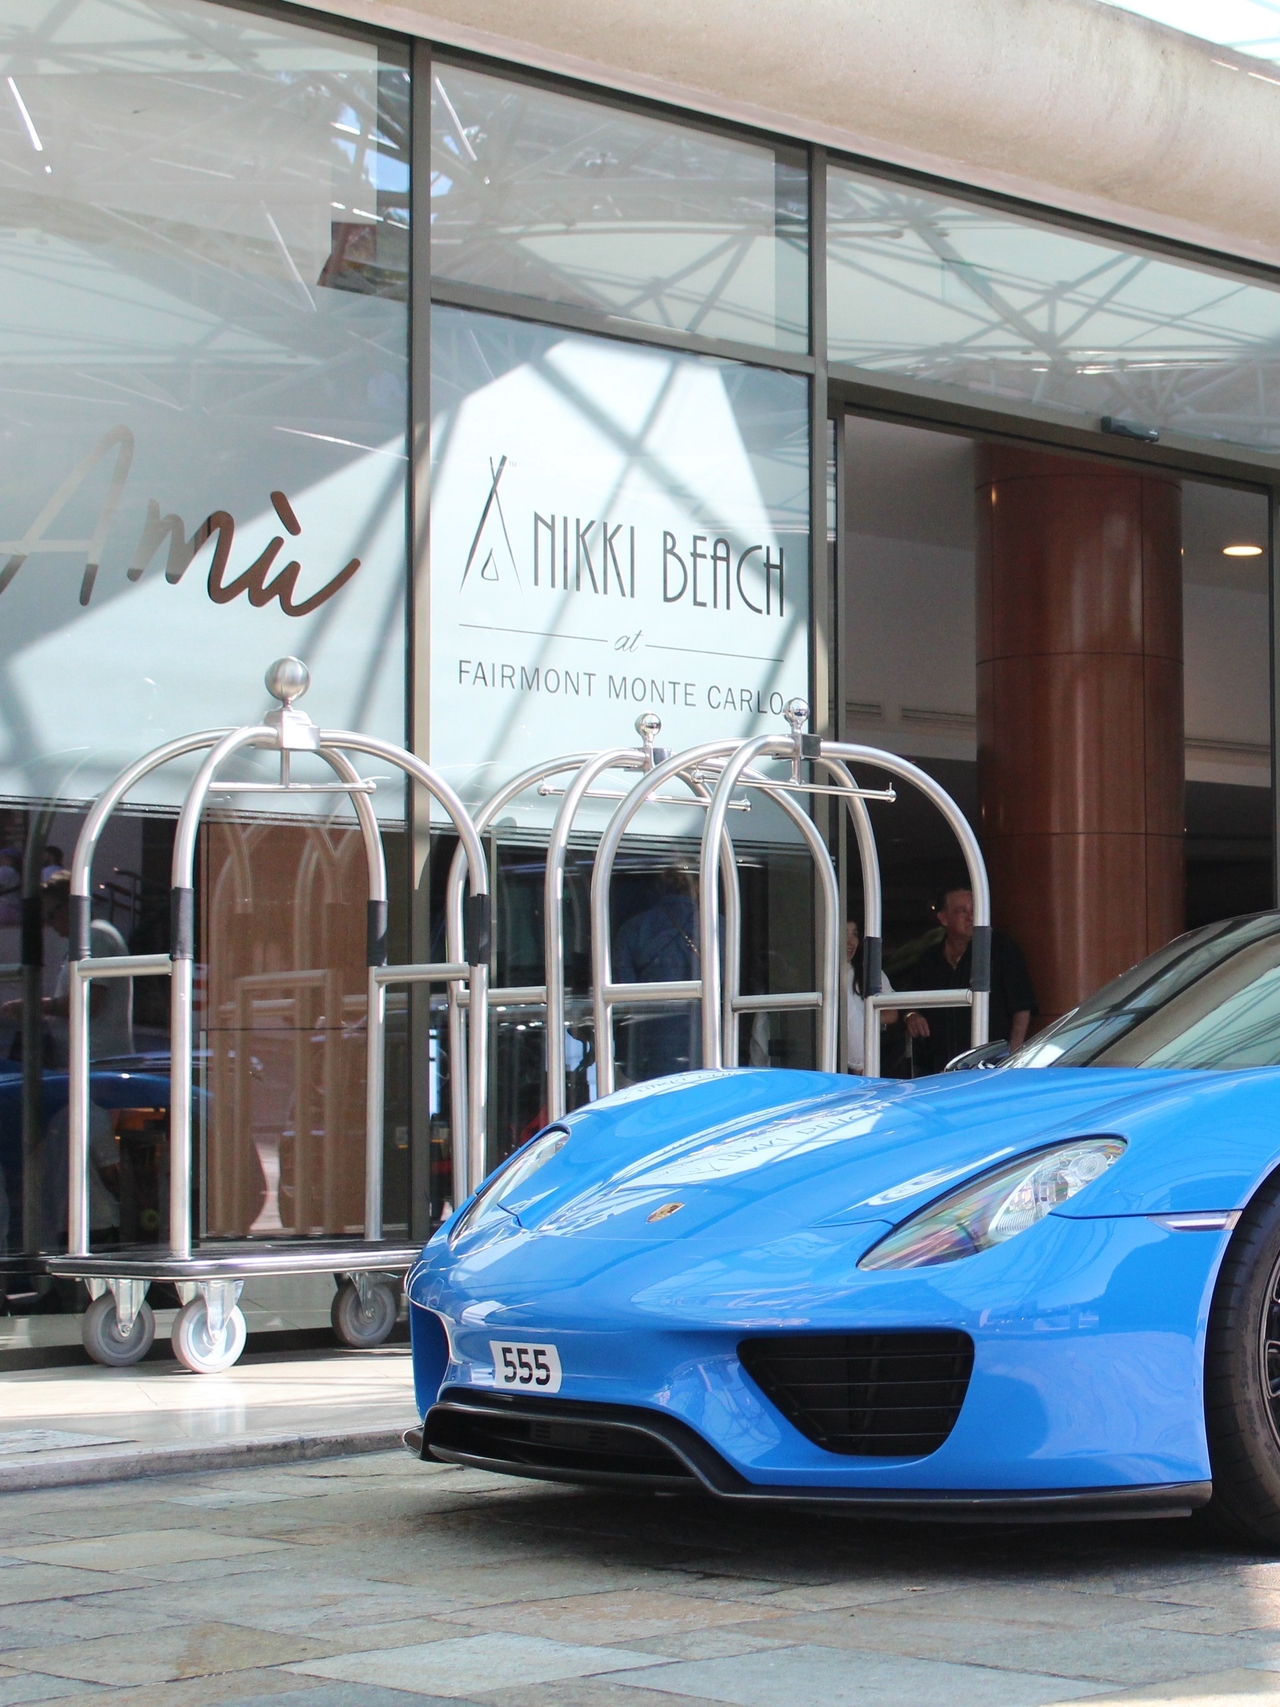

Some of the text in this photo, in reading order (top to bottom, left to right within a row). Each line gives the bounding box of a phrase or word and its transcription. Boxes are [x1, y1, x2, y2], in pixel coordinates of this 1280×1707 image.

[534, 511, 784, 617] NIKKI BEACH
[614, 629, 644, 653] at
[459, 659, 784, 715] FAIRMONT MONTE CARLO
[501, 1347, 551, 1386] 555
